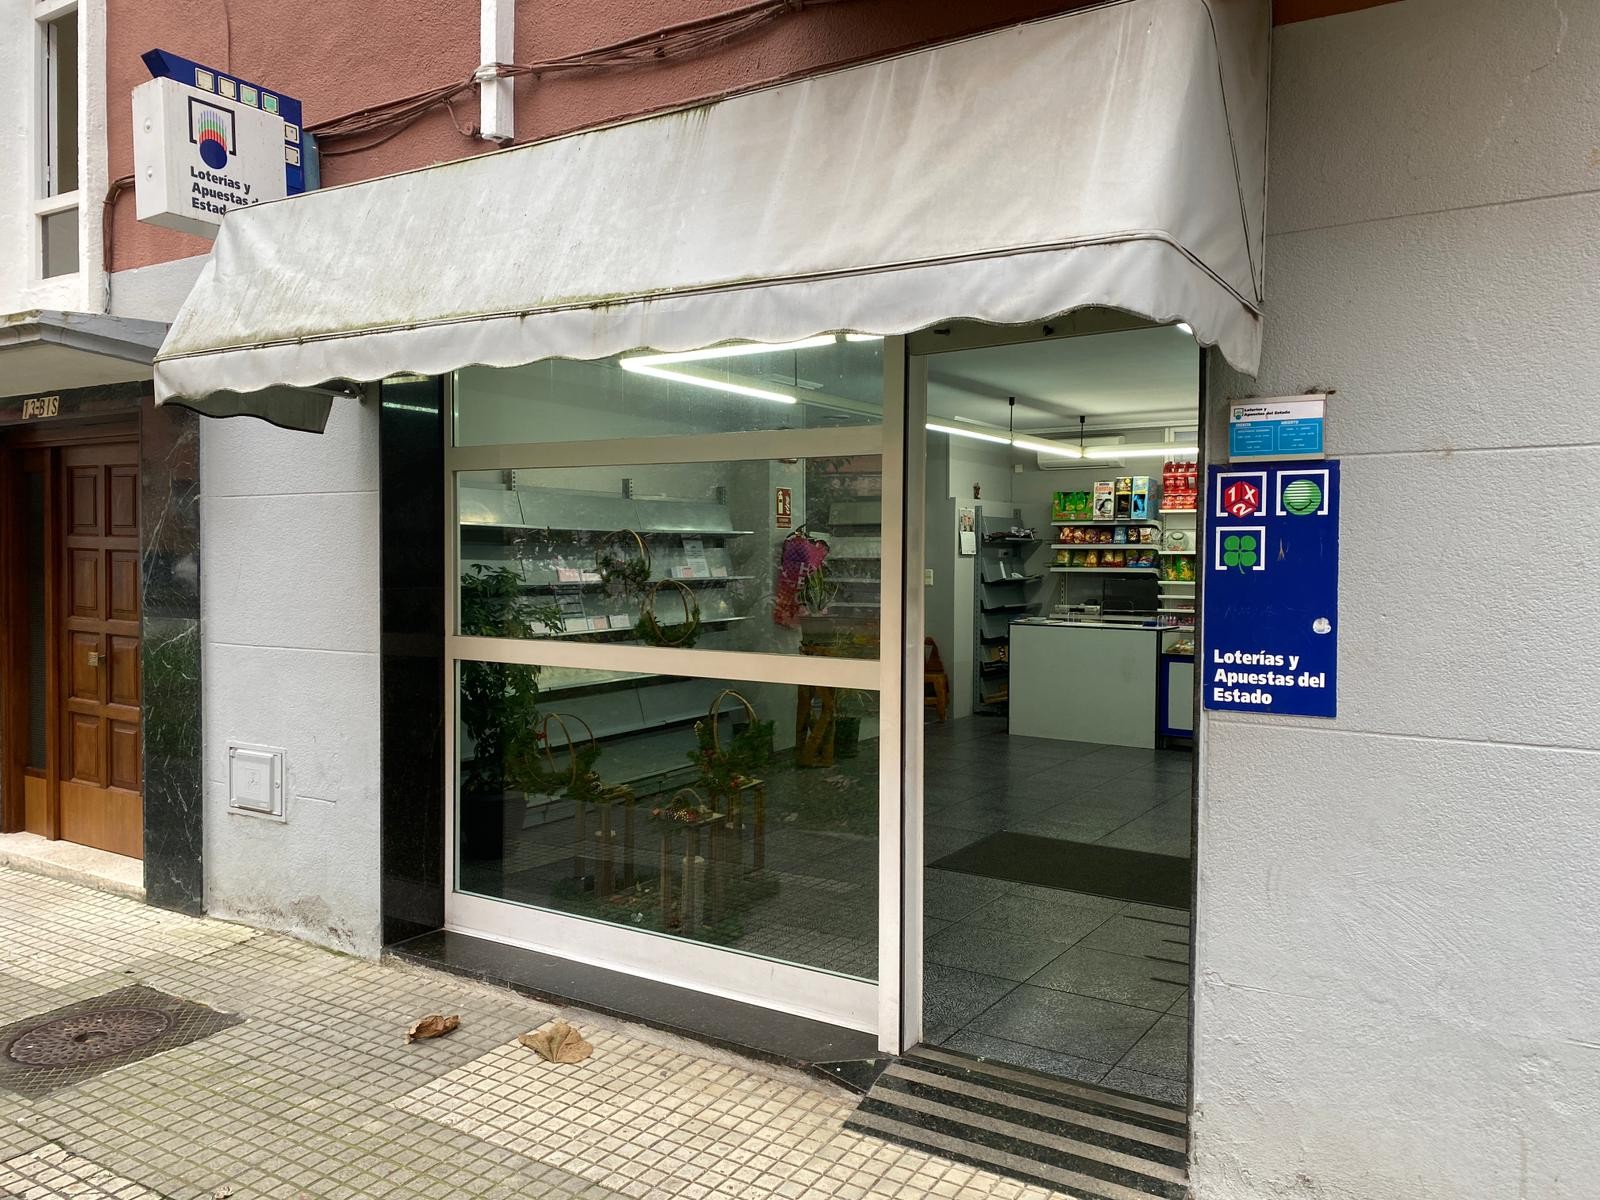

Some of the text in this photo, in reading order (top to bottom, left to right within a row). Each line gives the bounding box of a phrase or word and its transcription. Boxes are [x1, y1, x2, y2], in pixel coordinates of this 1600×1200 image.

[190, 165, 250, 195] Loterías y
[192, 182, 248, 205] Apuestas
[192, 197, 226, 215] Estad
[1213, 649, 1300, 671] Loterías y
[1213, 668, 1326, 688] Apuestas del
[1213, 687, 1273, 705] Estado
